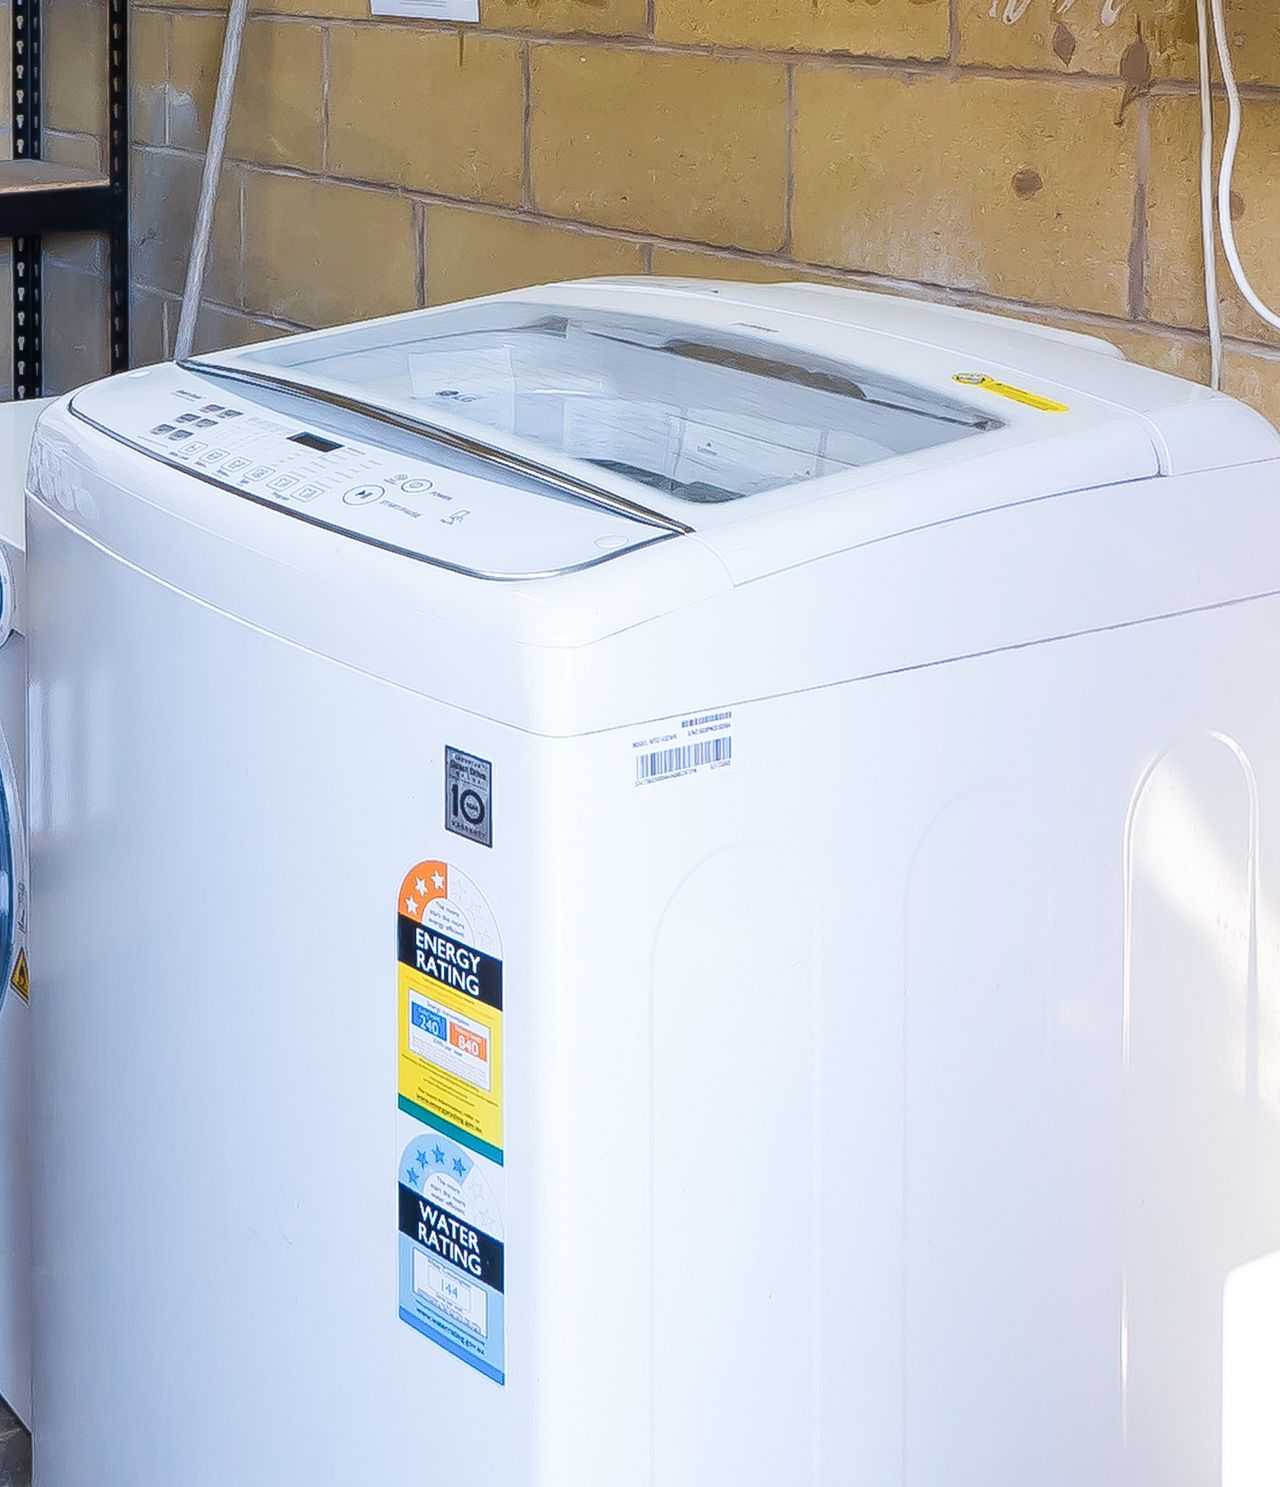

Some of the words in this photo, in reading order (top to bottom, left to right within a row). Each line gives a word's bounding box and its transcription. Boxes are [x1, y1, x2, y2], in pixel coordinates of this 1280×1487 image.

[451, 783, 485, 825] 10
[415, 927, 481, 974] ENERGY
[415, 949, 480, 996] RATING
[418, 1221, 482, 1275] RATING
[419, 1200, 480, 1254] WATER
